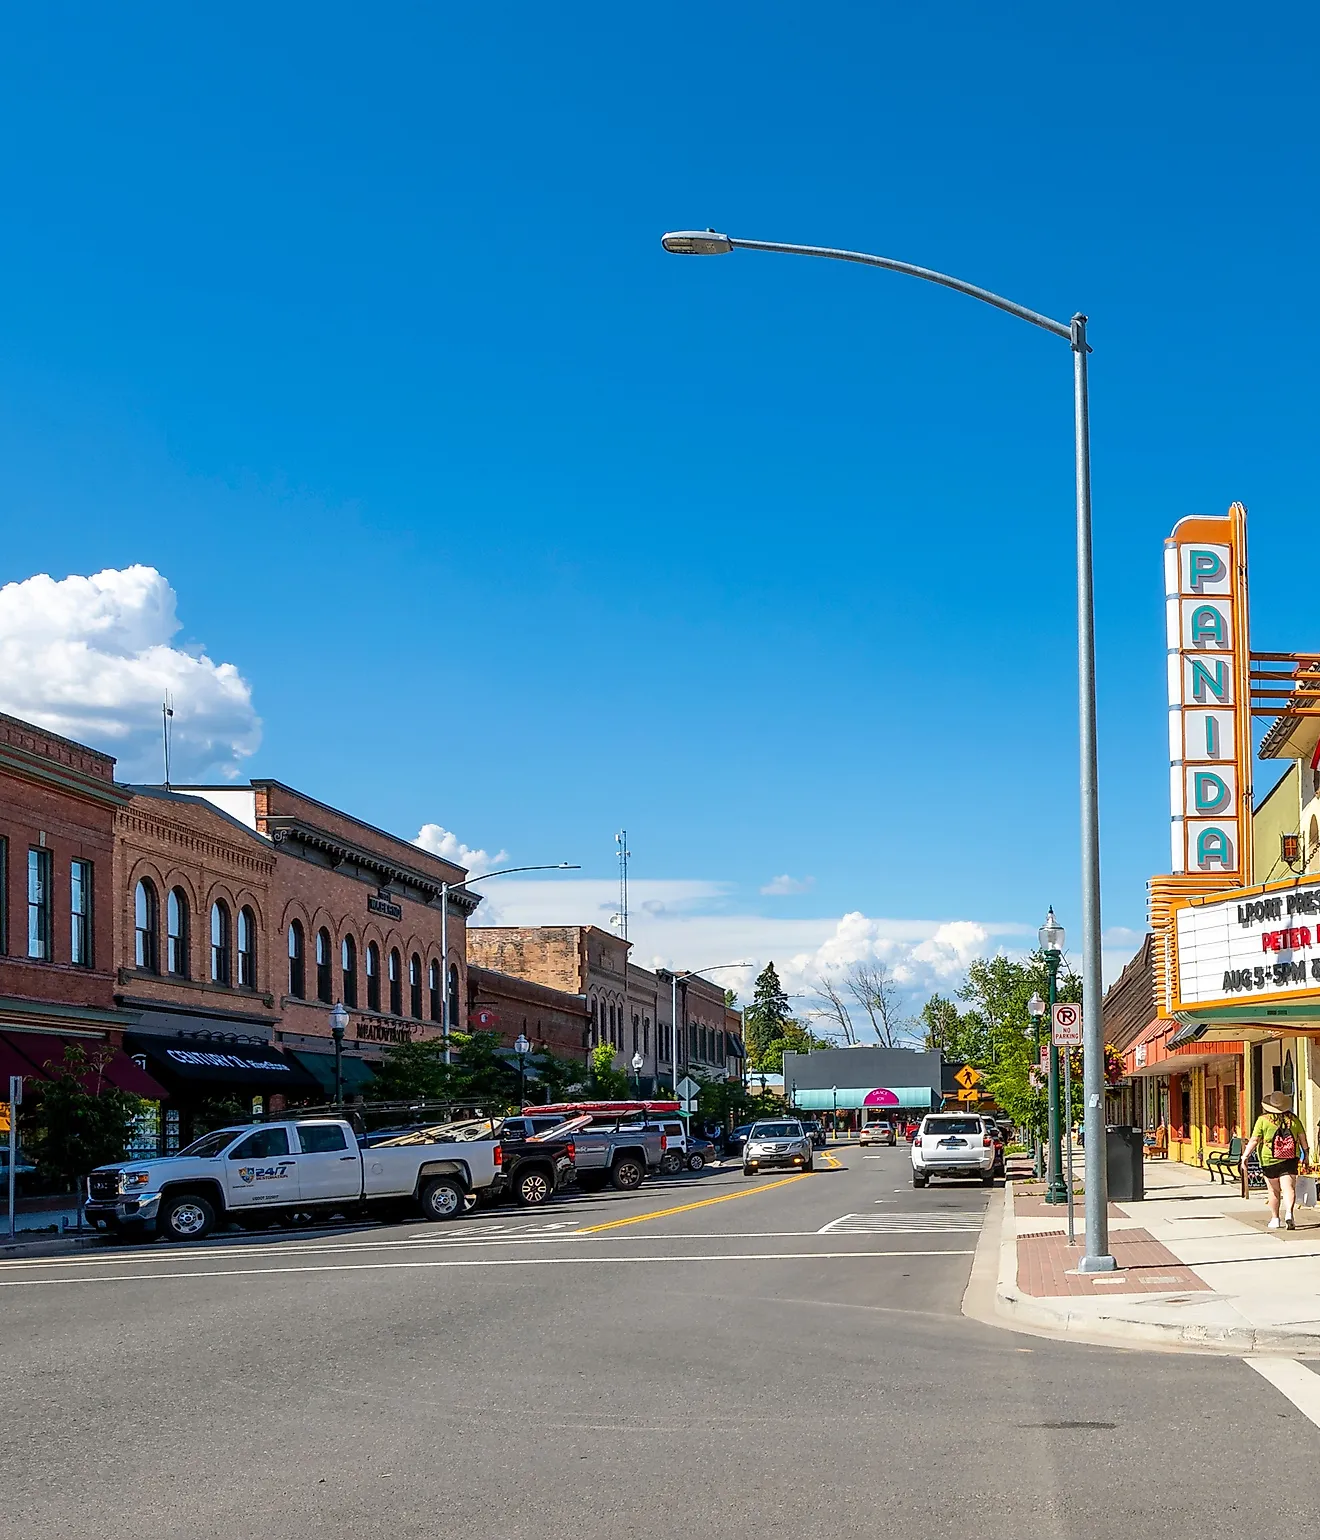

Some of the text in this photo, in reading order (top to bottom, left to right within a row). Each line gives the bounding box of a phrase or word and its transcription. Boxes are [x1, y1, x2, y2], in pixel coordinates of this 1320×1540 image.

[1189, 550, 1233, 870] PANIDA
[1262, 926, 1311, 952] PETER
[1222, 968, 1252, 992] AUG
[167, 1049, 232, 1067] CENTURY
